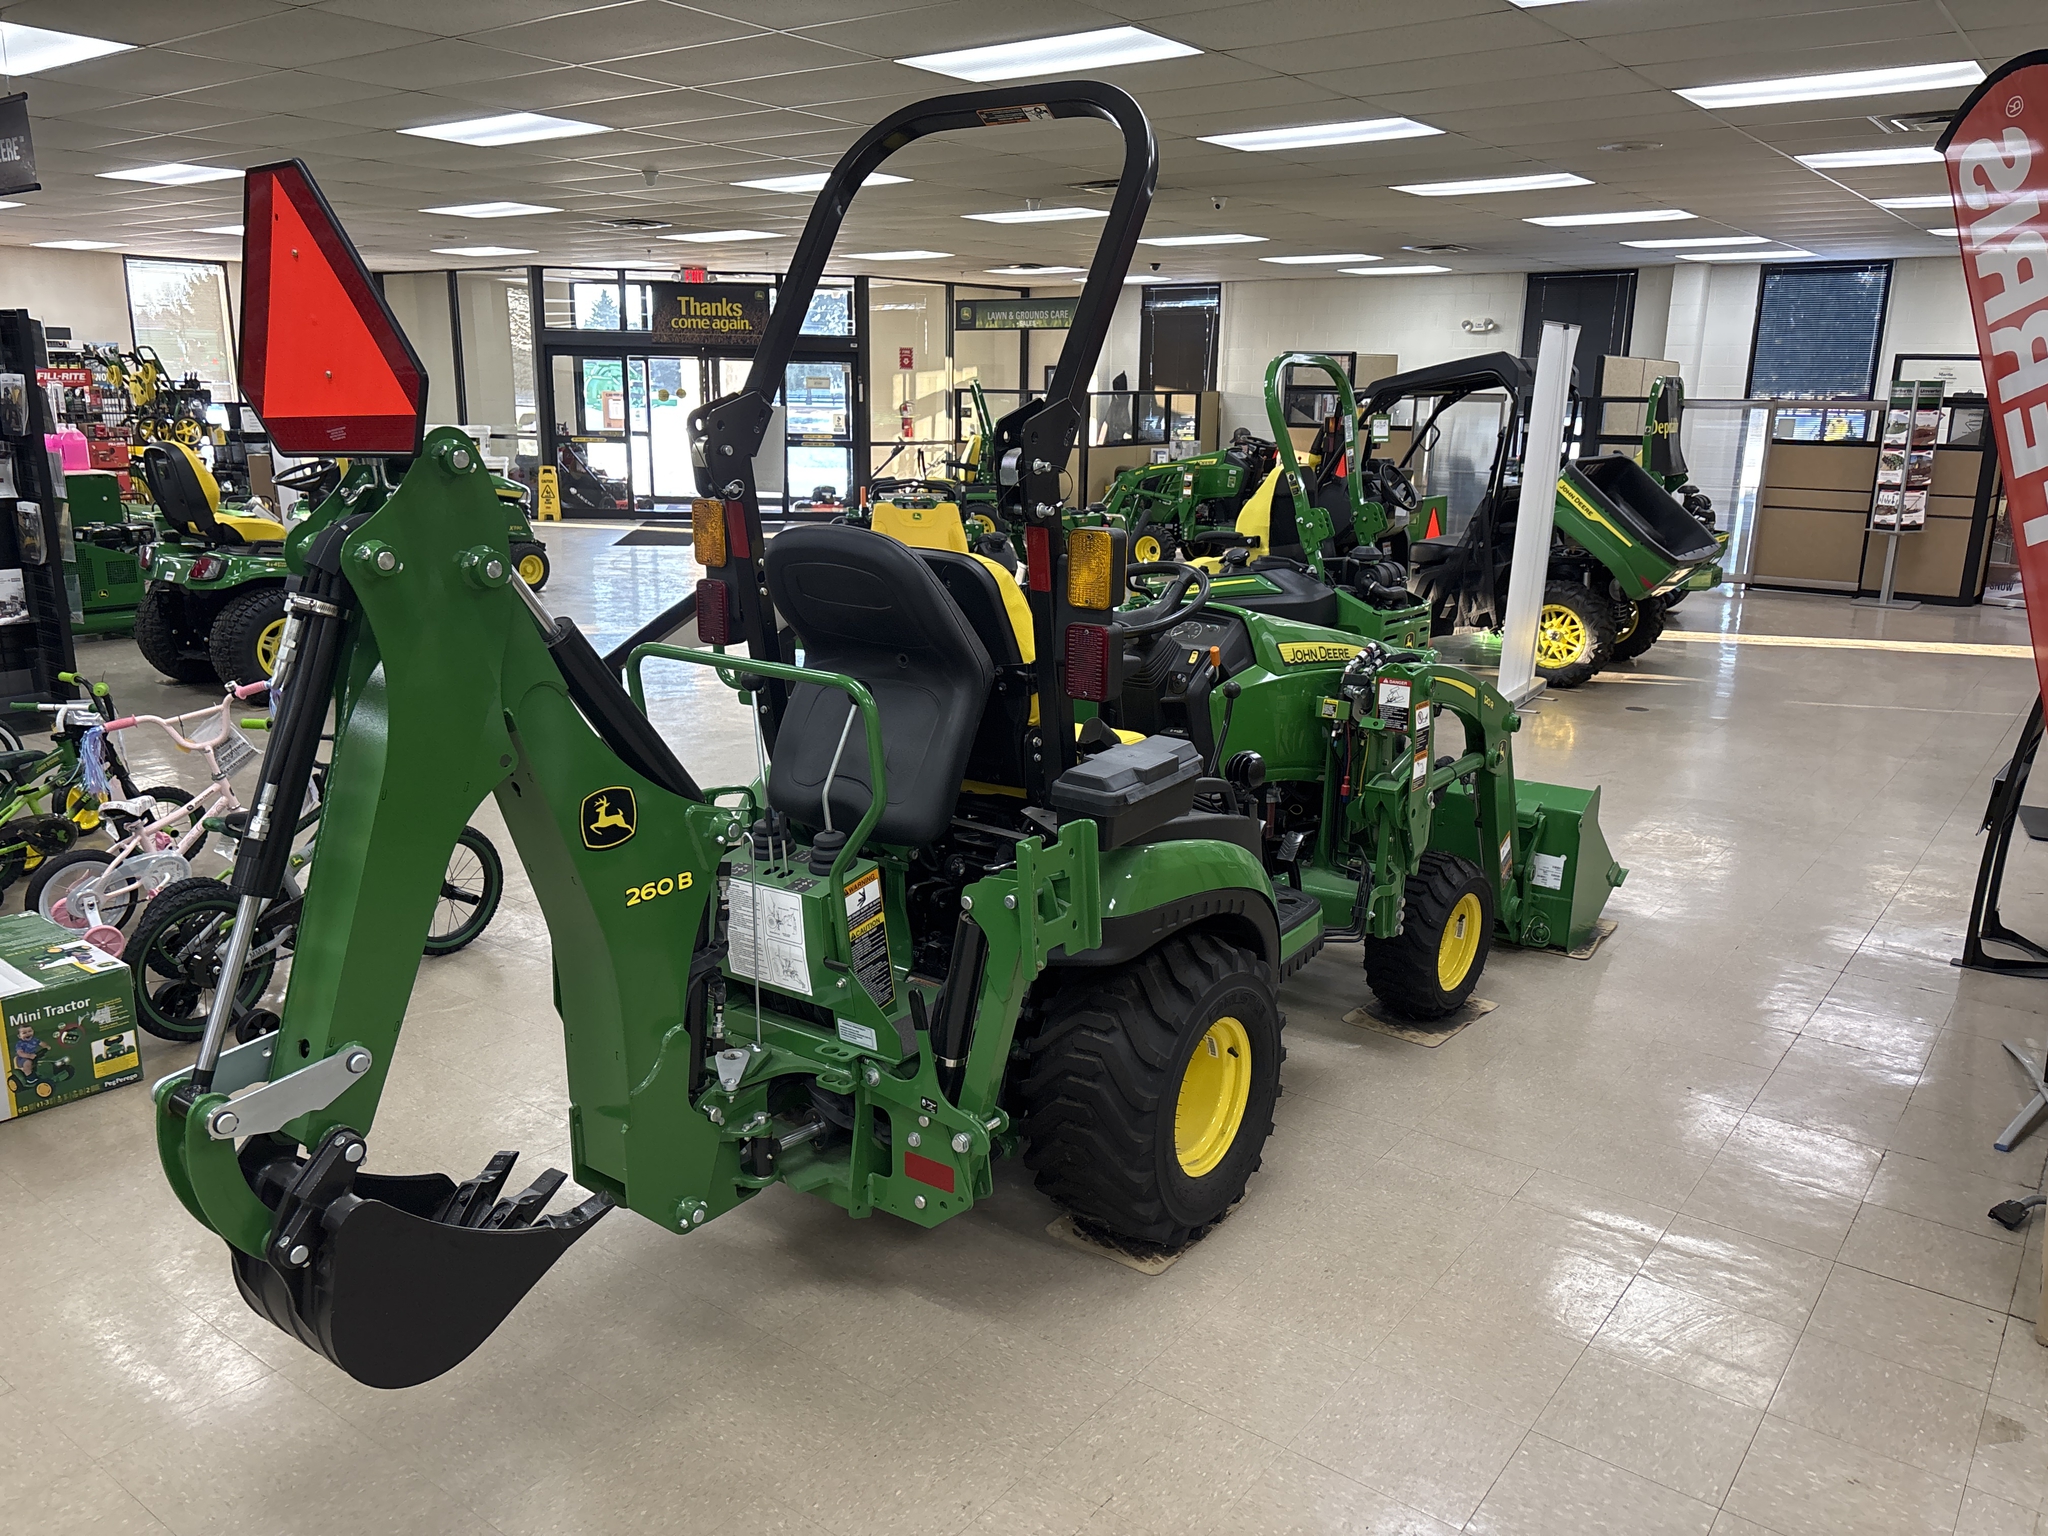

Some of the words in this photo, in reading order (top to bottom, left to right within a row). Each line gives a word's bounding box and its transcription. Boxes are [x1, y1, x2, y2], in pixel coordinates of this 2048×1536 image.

[684, 269, 705, 283] EXIT
[677, 296, 743, 317] Thanks
[987, 311, 1008, 320] LAWN
[1008, 310, 1014, 319] &
[1015, 309, 1049, 319] GROUNDS
[1050, 309, 1069, 318] CARE
[671, 317, 710, 329] come
[711, 316, 753, 332] again.
[36, 372, 86, 380] FILL-RITE
[1559, 484, 1576, 501] JOHN
[1574, 496, 1594, 517] DEERE
[1290, 648, 1318, 662] JOHN
[1318, 646, 1351, 660] DEERE
[625, 877, 675, 907] 260
[677, 871, 694, 891] B
[848, 873, 876, 894] WARNING
[855, 917, 881, 937] CAUTION
[9, 1009, 41, 1027] Mini
[42, 998, 91, 1018] Tractor
